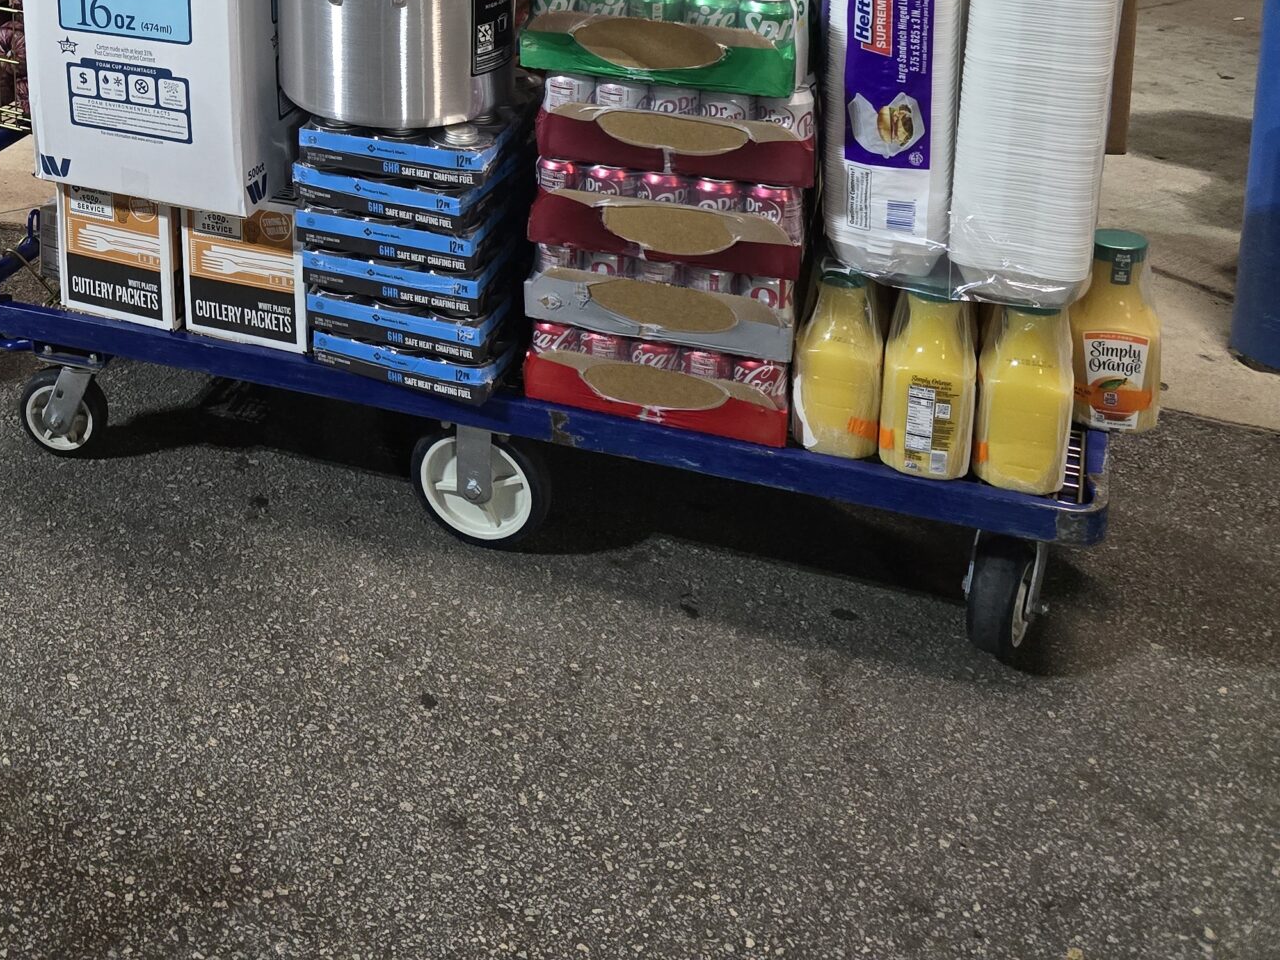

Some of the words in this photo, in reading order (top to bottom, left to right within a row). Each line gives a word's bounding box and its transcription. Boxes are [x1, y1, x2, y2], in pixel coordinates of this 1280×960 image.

[898, 7, 910, 30] Hinged
[911, 8, 921, 18] IN.
[114, 14, 136, 30] oz
[141, 22, 172, 34] (474ml)
[62, 43, 74, 51] USA
[897, 31, 907, 63] Sandwich
[910, 30, 920, 50] 5.625
[103, 50, 122, 58] Consumer
[123, 53, 139, 62] Recycled
[140, 55, 155, 63] Content
[910, 56, 919, 72] 5.75
[123, 65, 156, 75] ADVANTAGES
[896, 64, 908, 83] Large
[105, 102, 151, 113] ENVIRONMENTAL
[248, 162, 265, 181] 500ct
[382, 161, 400, 174] 6HR
[401, 167, 415, 177] SAFE
[416, 169, 431, 179] HEAT
[433, 171, 458, 182] CHAFING
[459, 174, 473, 185] FUEL
[77, 202, 105, 213] SERVICE
[746, 198, 763, 211] Dr
[208, 212, 226, 223] FOOD
[201, 223, 232, 234] SERVICE
[72, 275, 114, 300] CUTLERY
[116, 285, 158, 310] PACKETS
[128, 278, 141, 288] WHITE
[142, 281, 158, 292] PLASTIC
[195, 299, 241, 324] CUTLERY
[244, 308, 292, 334] PACKETS
[258, 302, 272, 312] WHITE
[273, 304, 291, 315] PLASTIC
[1090, 340, 1141, 364] Simply
[1089, 358, 1142, 376] Orange
[387, 371, 403, 383] 6HR
[404, 377, 417, 387] SAFE
[418, 379, 432, 390] HEAT
[433, 383, 458, 396] CHAFING
[458, 388, 471, 399] FUEL
